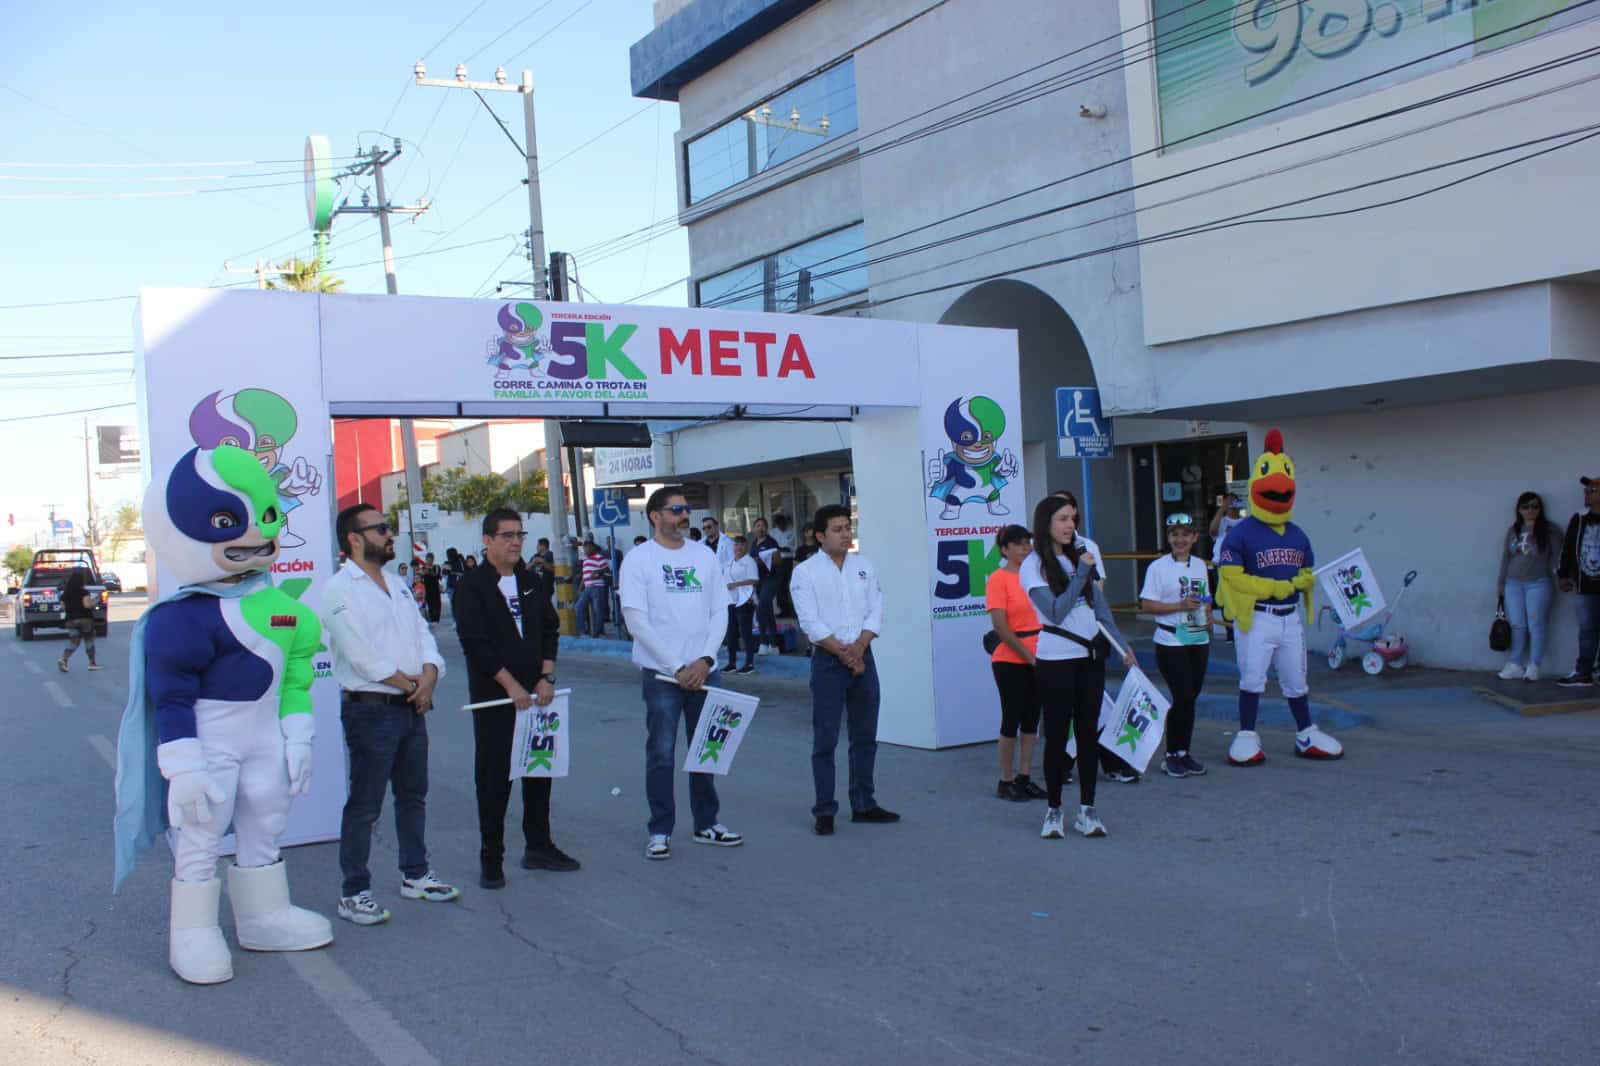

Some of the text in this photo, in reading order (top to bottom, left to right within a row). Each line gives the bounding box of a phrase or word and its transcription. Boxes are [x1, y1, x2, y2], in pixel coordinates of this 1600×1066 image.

[547, 321, 647, 380] 5K
[659, 328, 816, 379] META
[494, 390, 541, 398] FAMILIA
[544, 390, 553, 398] A
[555, 390, 592, 398] FAVOR
[595, 390, 615, 398] DEL
[537, 380, 582, 389] CAMINA
[585, 381, 594, 389] O
[596, 381, 631, 389] TROTA
[633, 382, 647, 390] EN
[608, 455, 652, 475] 24 HORAS
[935, 527, 977, 536] TERCERA
[675, 569, 701, 587] 5K
[934, 539, 1001, 600] 5K
[958, 602, 986, 611] CAMINA
[1343, 582, 1373, 619] 5K
[317, 662, 331, 670] EN
[1115, 707, 1151, 753] 5K
[527, 735, 555, 774] 5K
[698, 725, 729, 766] 5K
